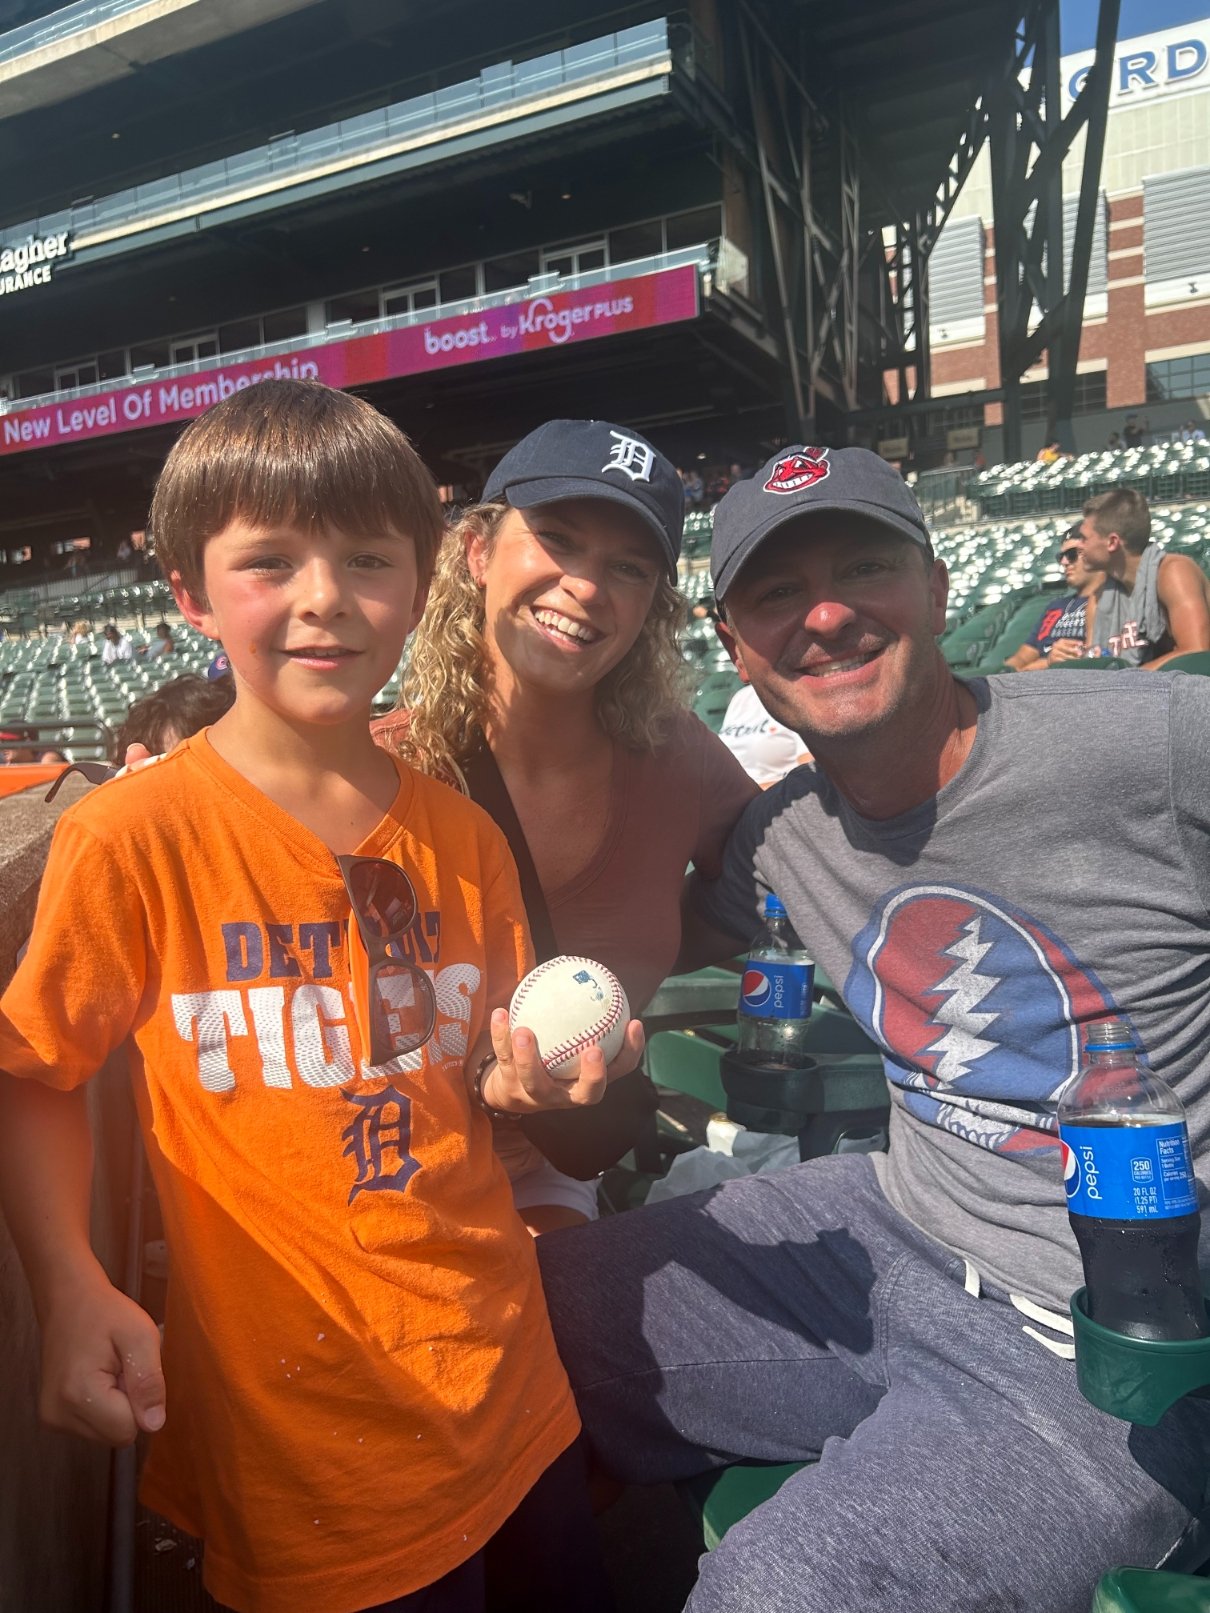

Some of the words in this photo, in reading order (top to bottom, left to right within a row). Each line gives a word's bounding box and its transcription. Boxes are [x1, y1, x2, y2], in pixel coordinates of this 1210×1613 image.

[0, 231, 69, 274] agher
[424, 327, 489, 354] boost
[501, 325, 518, 339] by
[518, 298, 594, 343] Kroger
[4, 418, 50, 444] New
[57, 398, 116, 434] Level
[123, 390, 152, 421] Of
[774, 975, 784, 1008] pepsi
[172, 963, 481, 1092] TIGES
[1080, 1146, 1102, 1199] pepsi
[1133, 1160, 1150, 1171] 250
[1133, 1187, 1140, 1196] 20
[1136, 1205, 1147, 1213] 591
